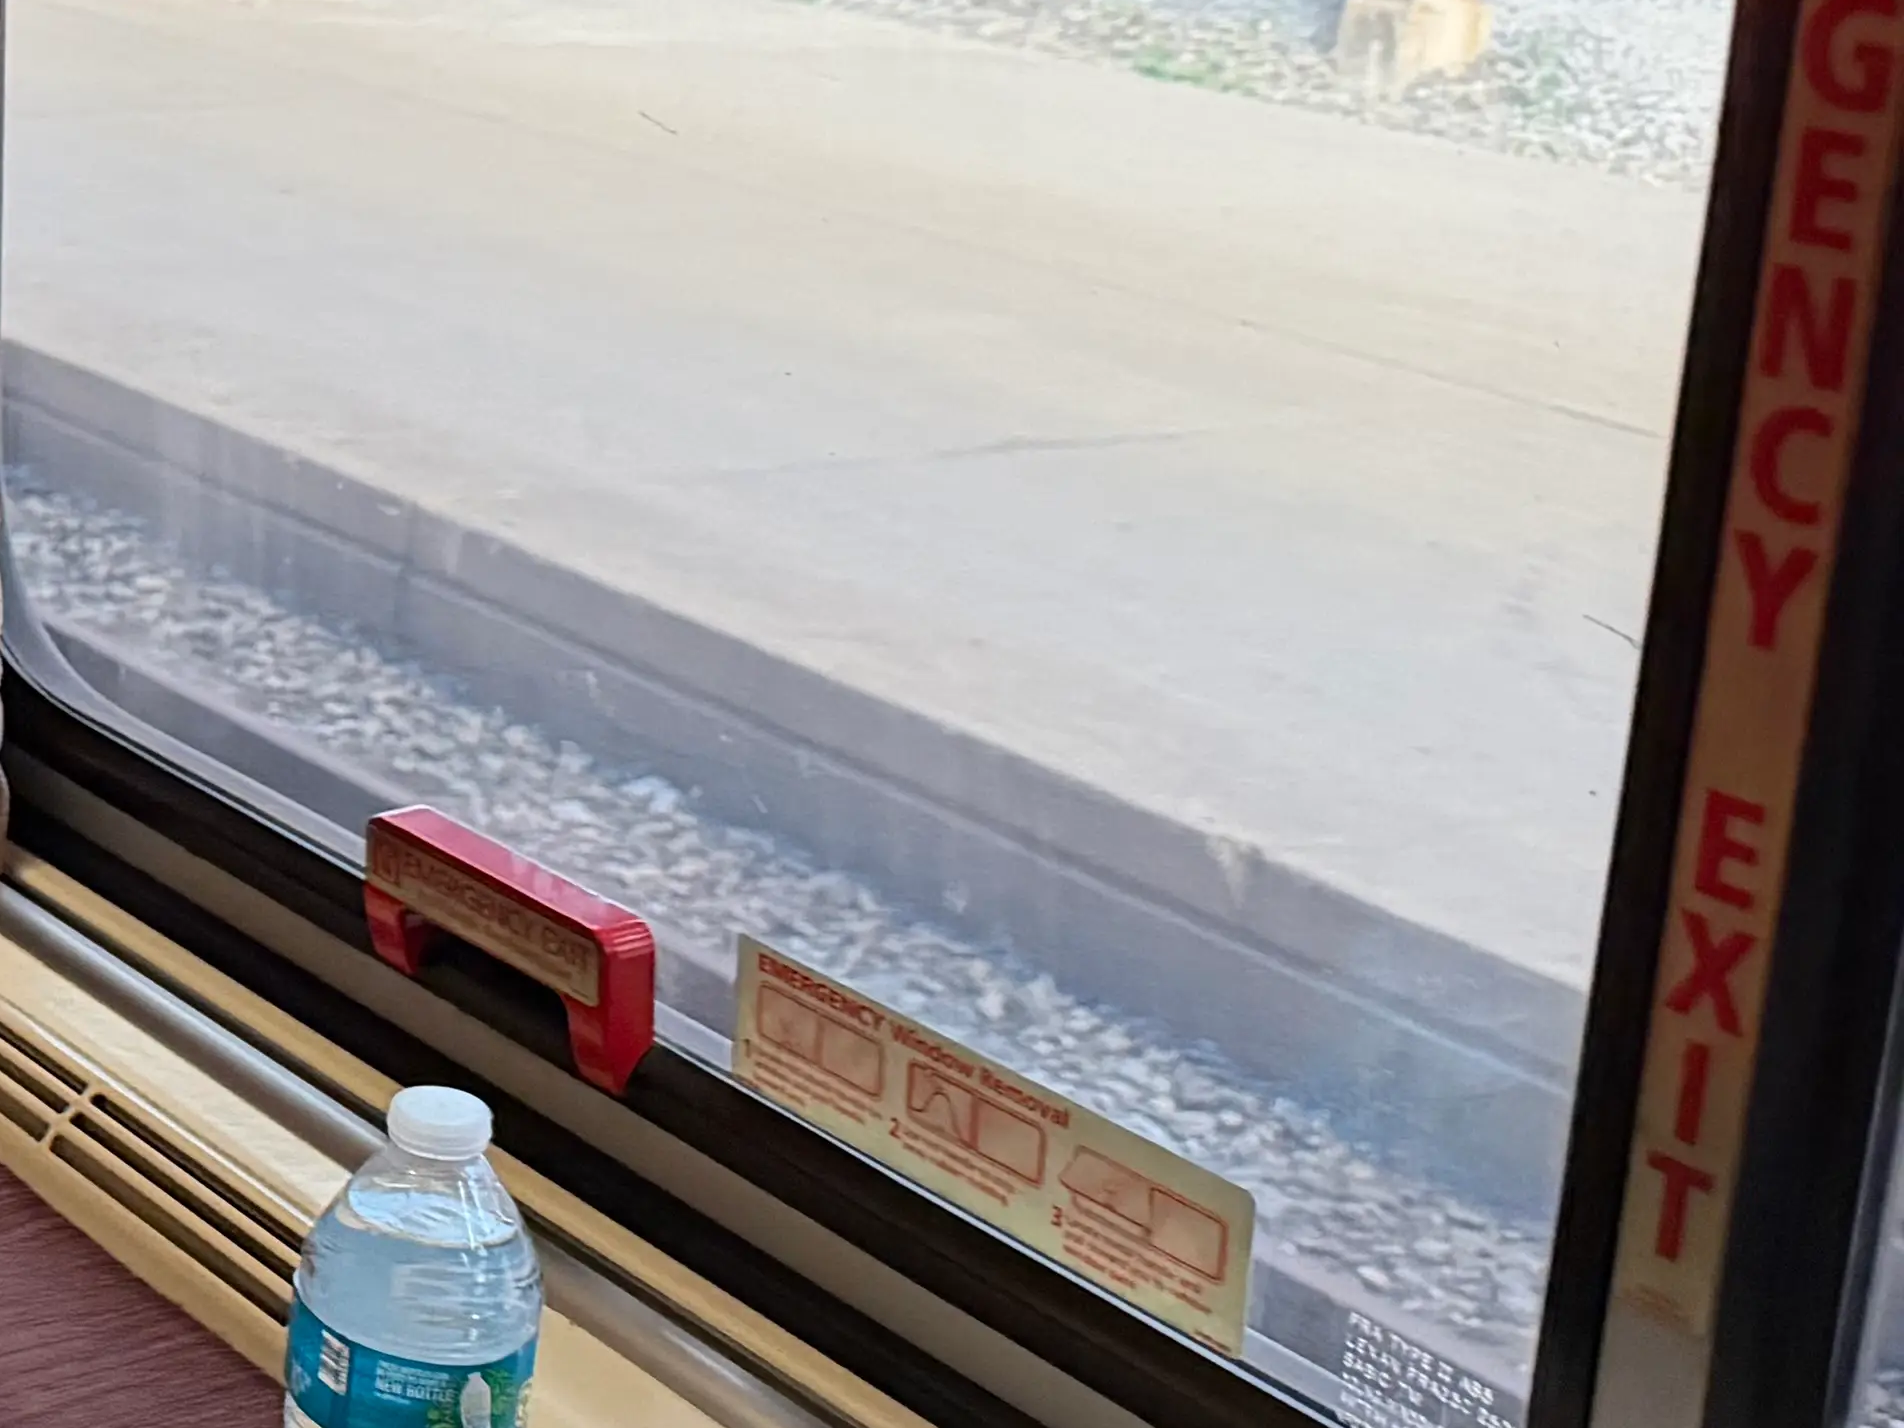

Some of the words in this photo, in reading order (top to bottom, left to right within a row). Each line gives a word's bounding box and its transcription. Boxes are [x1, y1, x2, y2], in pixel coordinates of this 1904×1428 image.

[758, 953, 886, 1032] EMERGENCY
[979, 1058, 1070, 1129] Removal
[1646, 788, 1765, 1263] EXIT
